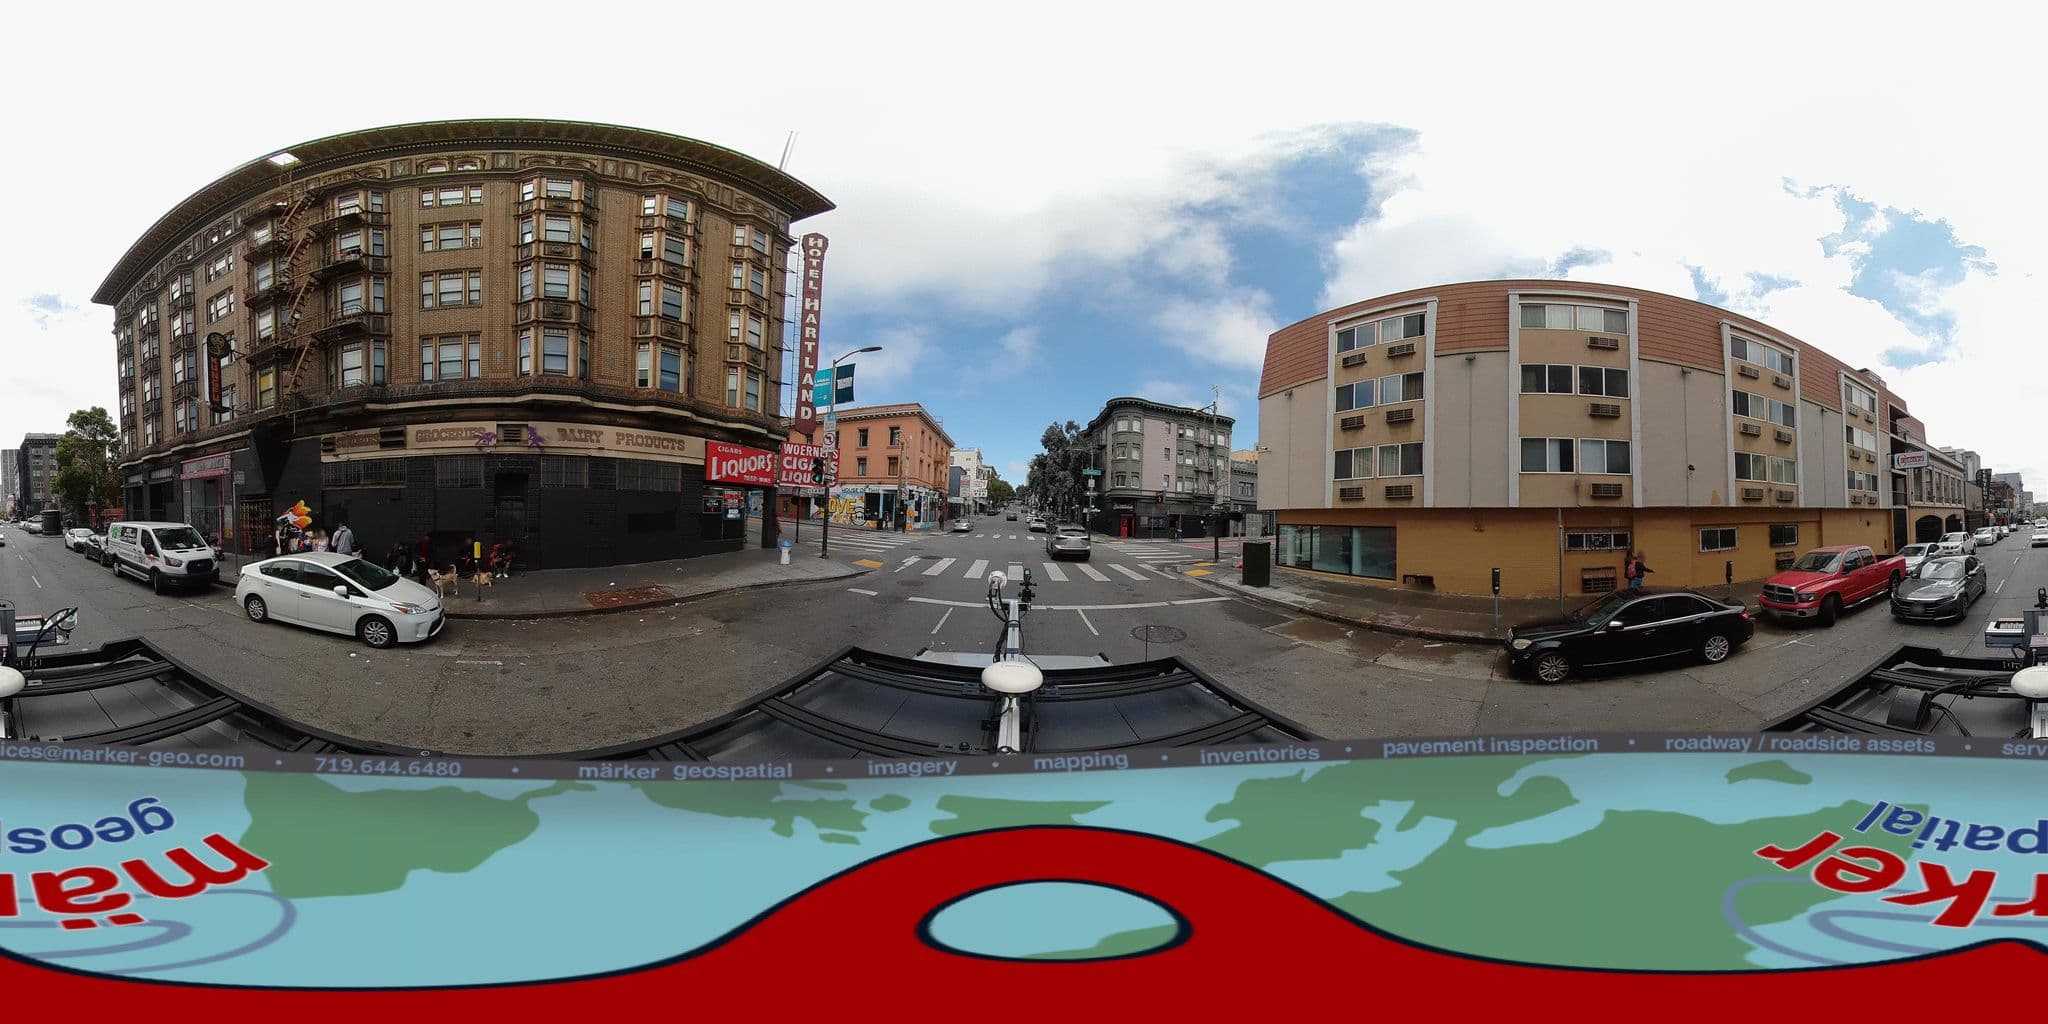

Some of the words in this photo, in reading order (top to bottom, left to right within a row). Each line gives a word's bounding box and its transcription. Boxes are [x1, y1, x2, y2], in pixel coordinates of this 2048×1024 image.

[808, 237, 823, 291] HOTEL
[800, 298, 820, 420] HARTLAND
[416, 426, 486, 443] GROCERIES
[557, 427, 604, 444] DAIRY
[615, 431, 686, 451] PRODUCTS
[717, 445, 743, 455] CIGARS
[711, 453, 773, 480] LIQUORS
[828, 497, 857, 514] OVE
